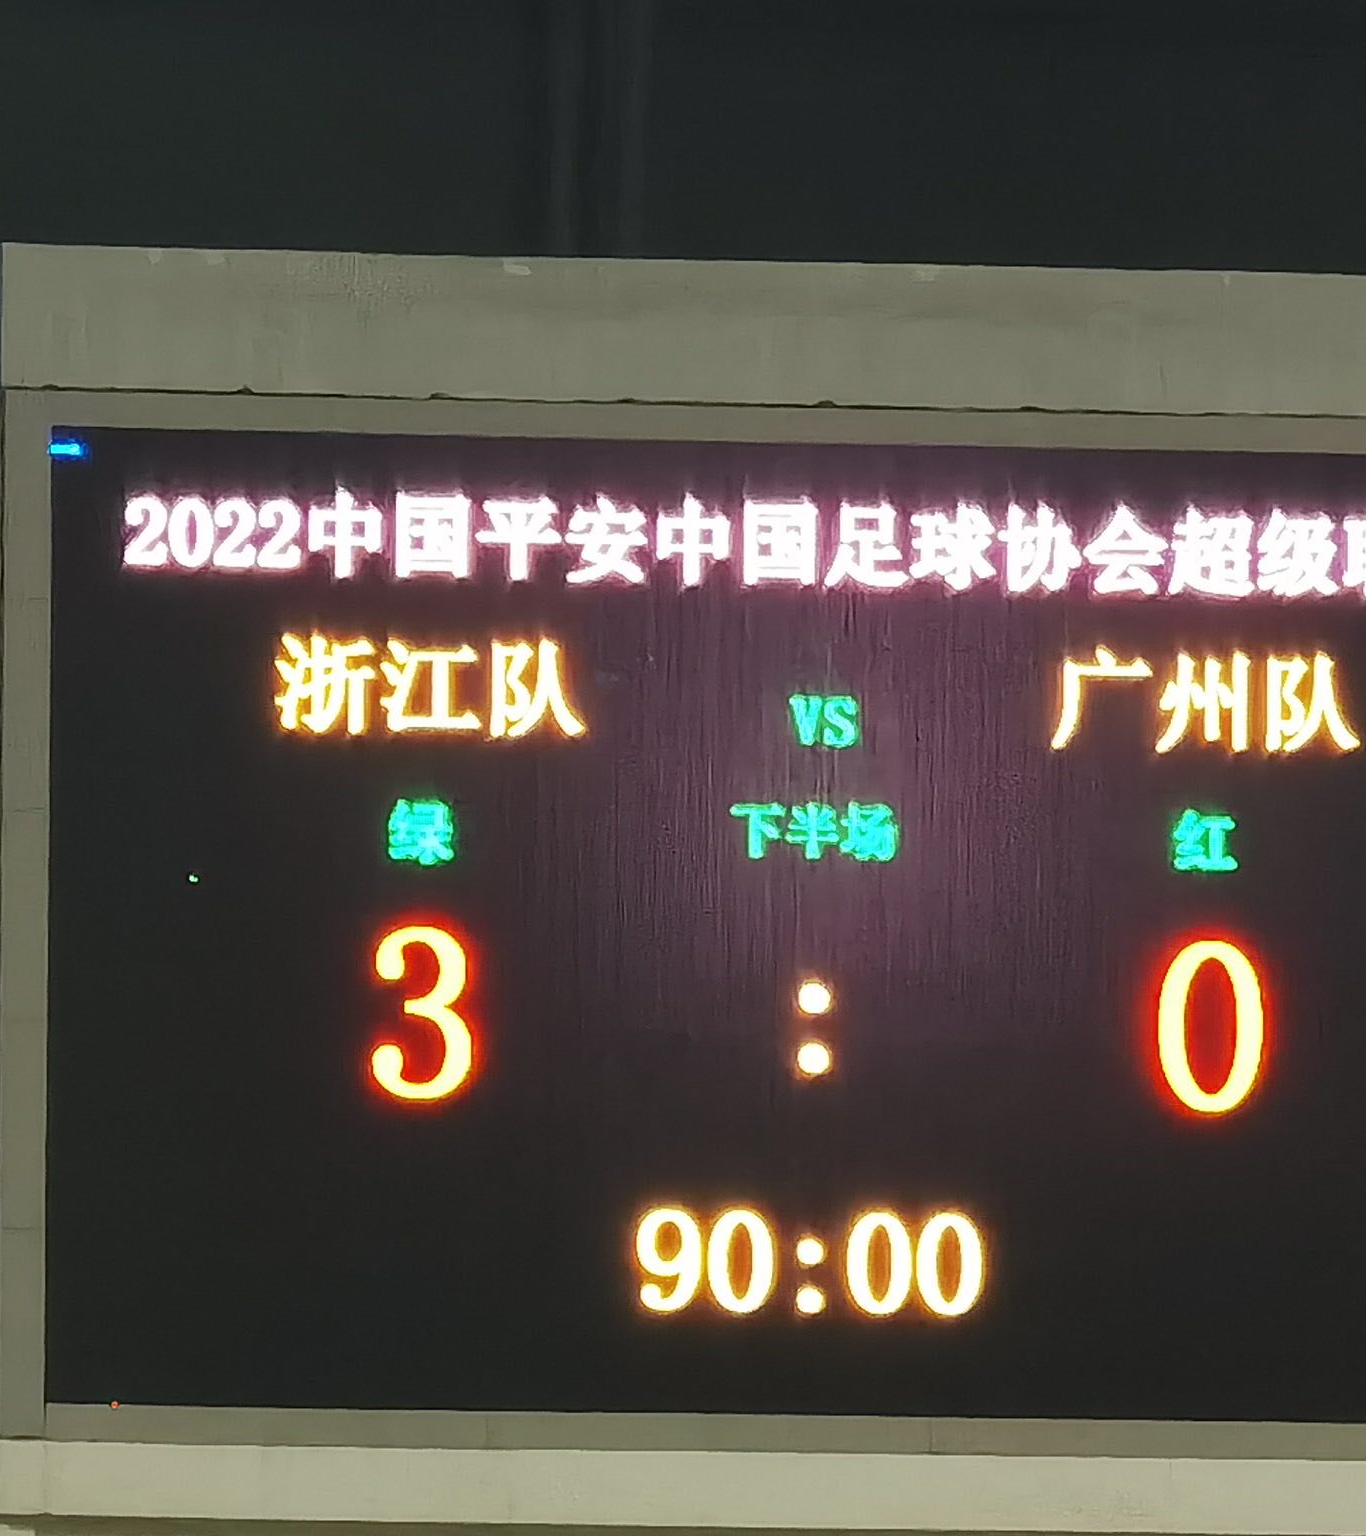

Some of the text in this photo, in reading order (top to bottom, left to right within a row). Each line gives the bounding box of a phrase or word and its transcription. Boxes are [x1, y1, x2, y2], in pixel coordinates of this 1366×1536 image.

[273, 632, 586, 738] 浙江队
[789, 692, 859, 748] VS
[1051, 646, 1361, 754] 广州队
[387, 798, 455, 864] 绿
[729, 800, 899, 864] 下半场
[1171, 808, 1237, 872] 红
[369, 922, 479, 1104] 3
[1153, 936, 1271, 1116] 0
[633, 1204, 987, 1320] 90:00
